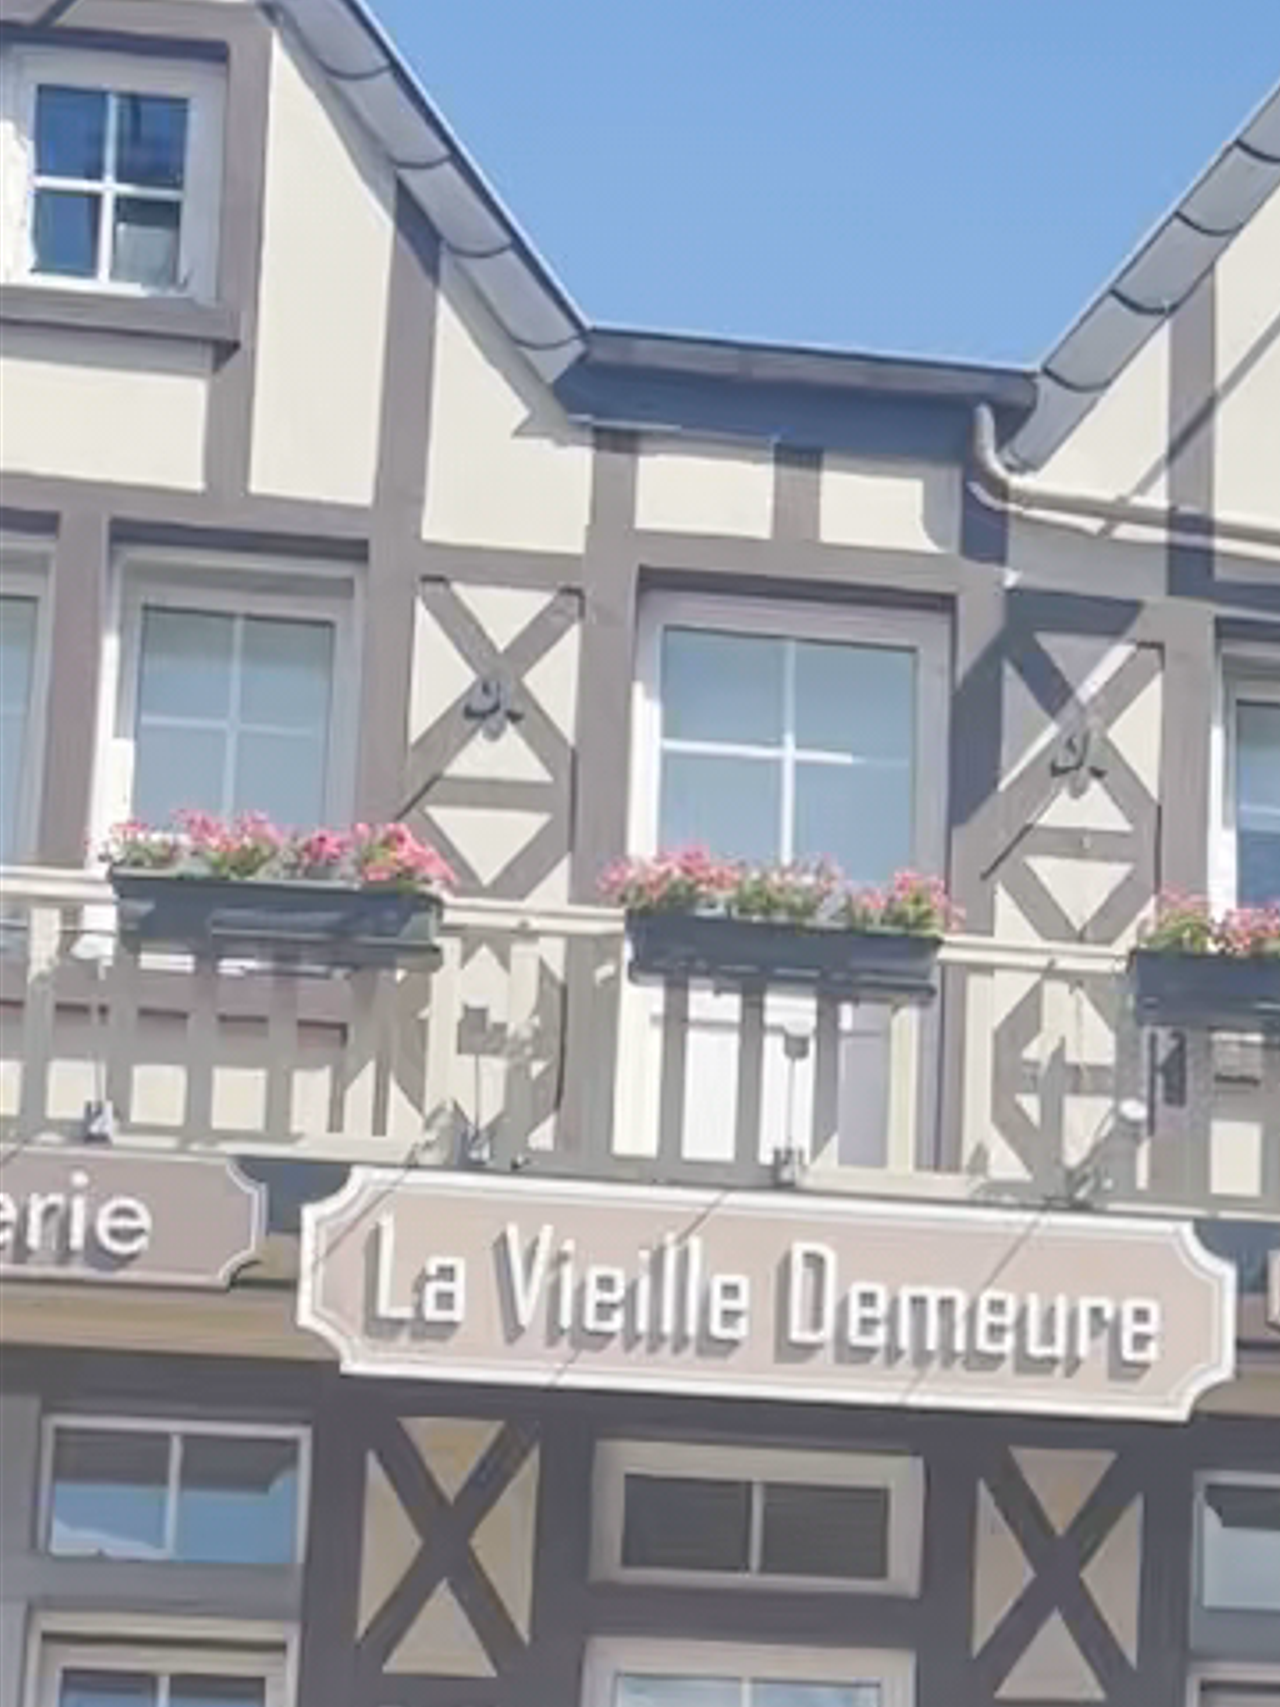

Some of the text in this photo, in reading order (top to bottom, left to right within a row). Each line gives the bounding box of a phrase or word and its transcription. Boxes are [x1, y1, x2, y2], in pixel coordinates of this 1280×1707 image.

[378, 1214, 1162, 1363] La Vieille Demeure
